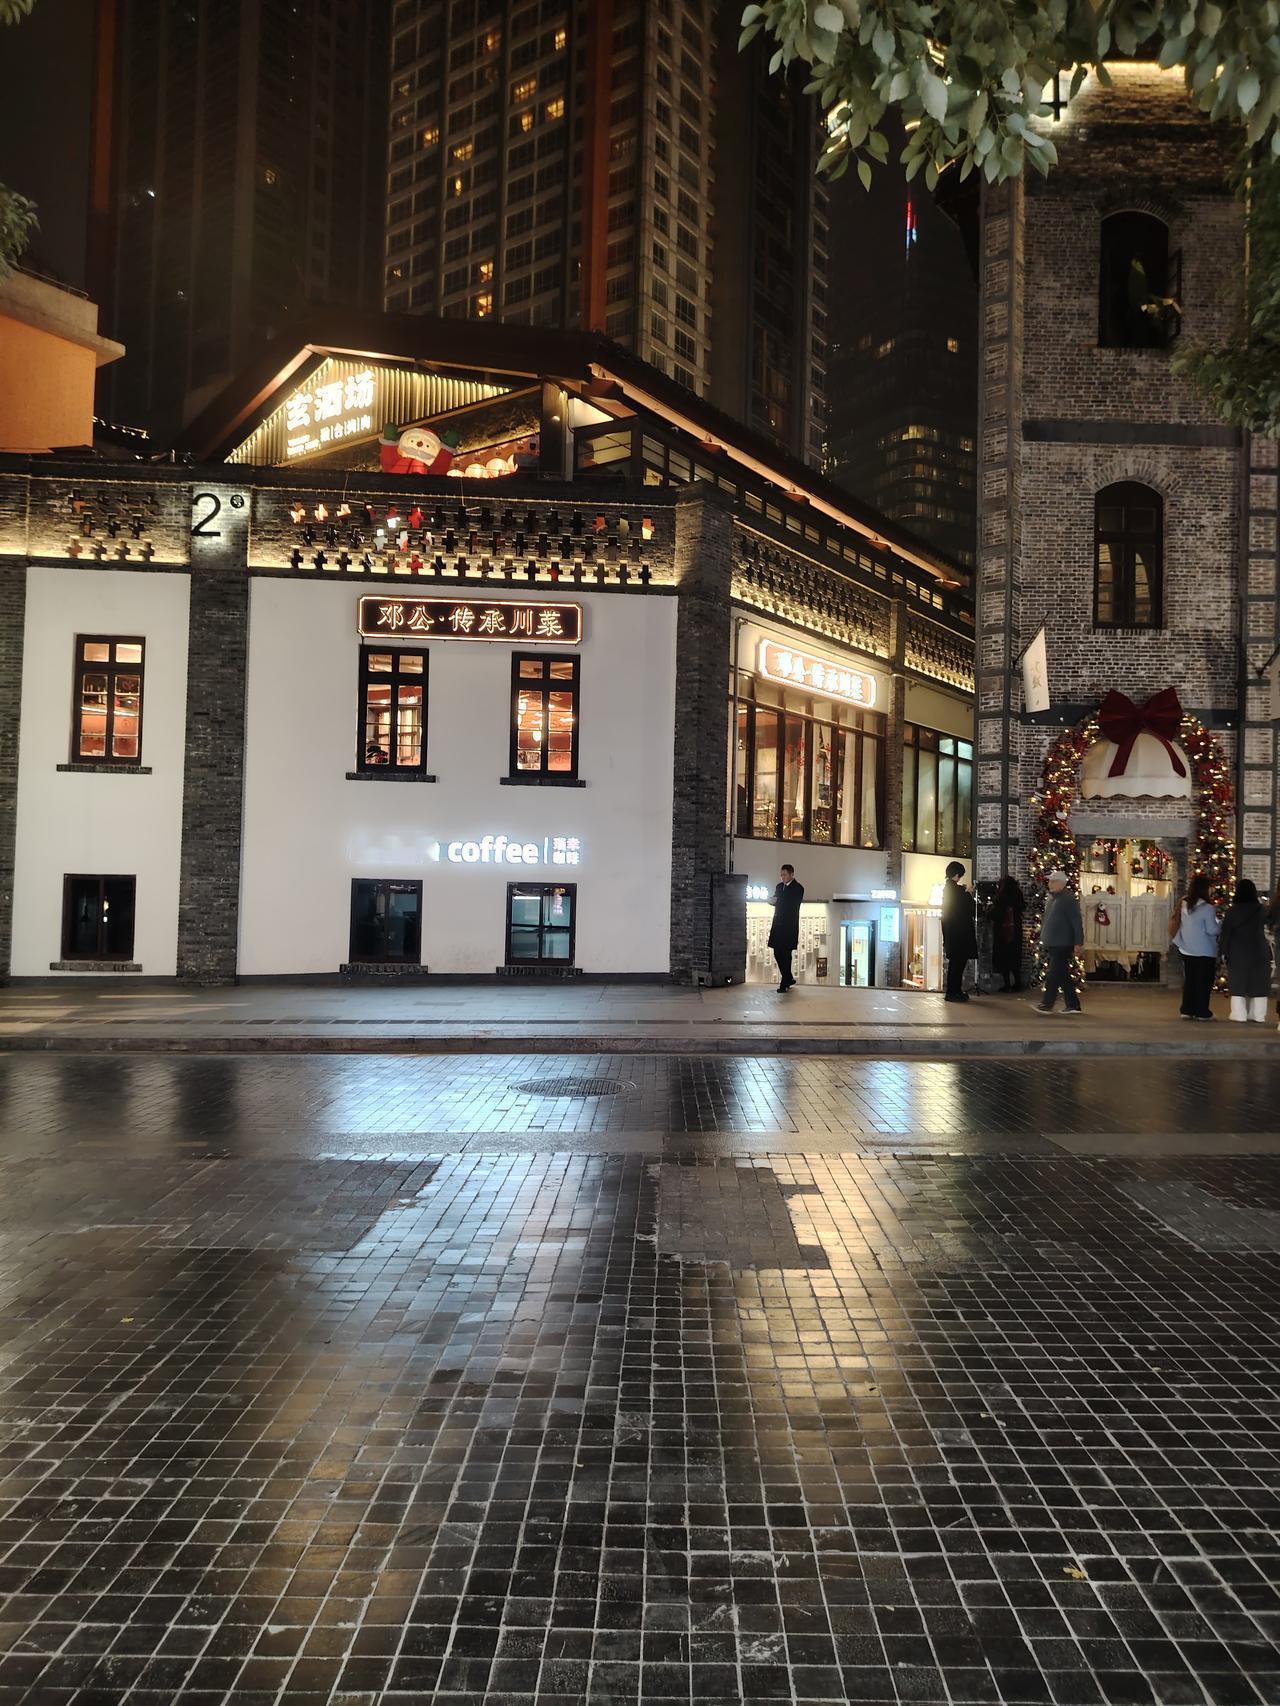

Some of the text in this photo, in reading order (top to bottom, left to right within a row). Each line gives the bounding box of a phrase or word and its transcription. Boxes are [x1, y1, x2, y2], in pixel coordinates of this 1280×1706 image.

[377, 604, 563, 636] 邓公·传承川菜
[448, 835, 539, 864] coffee
